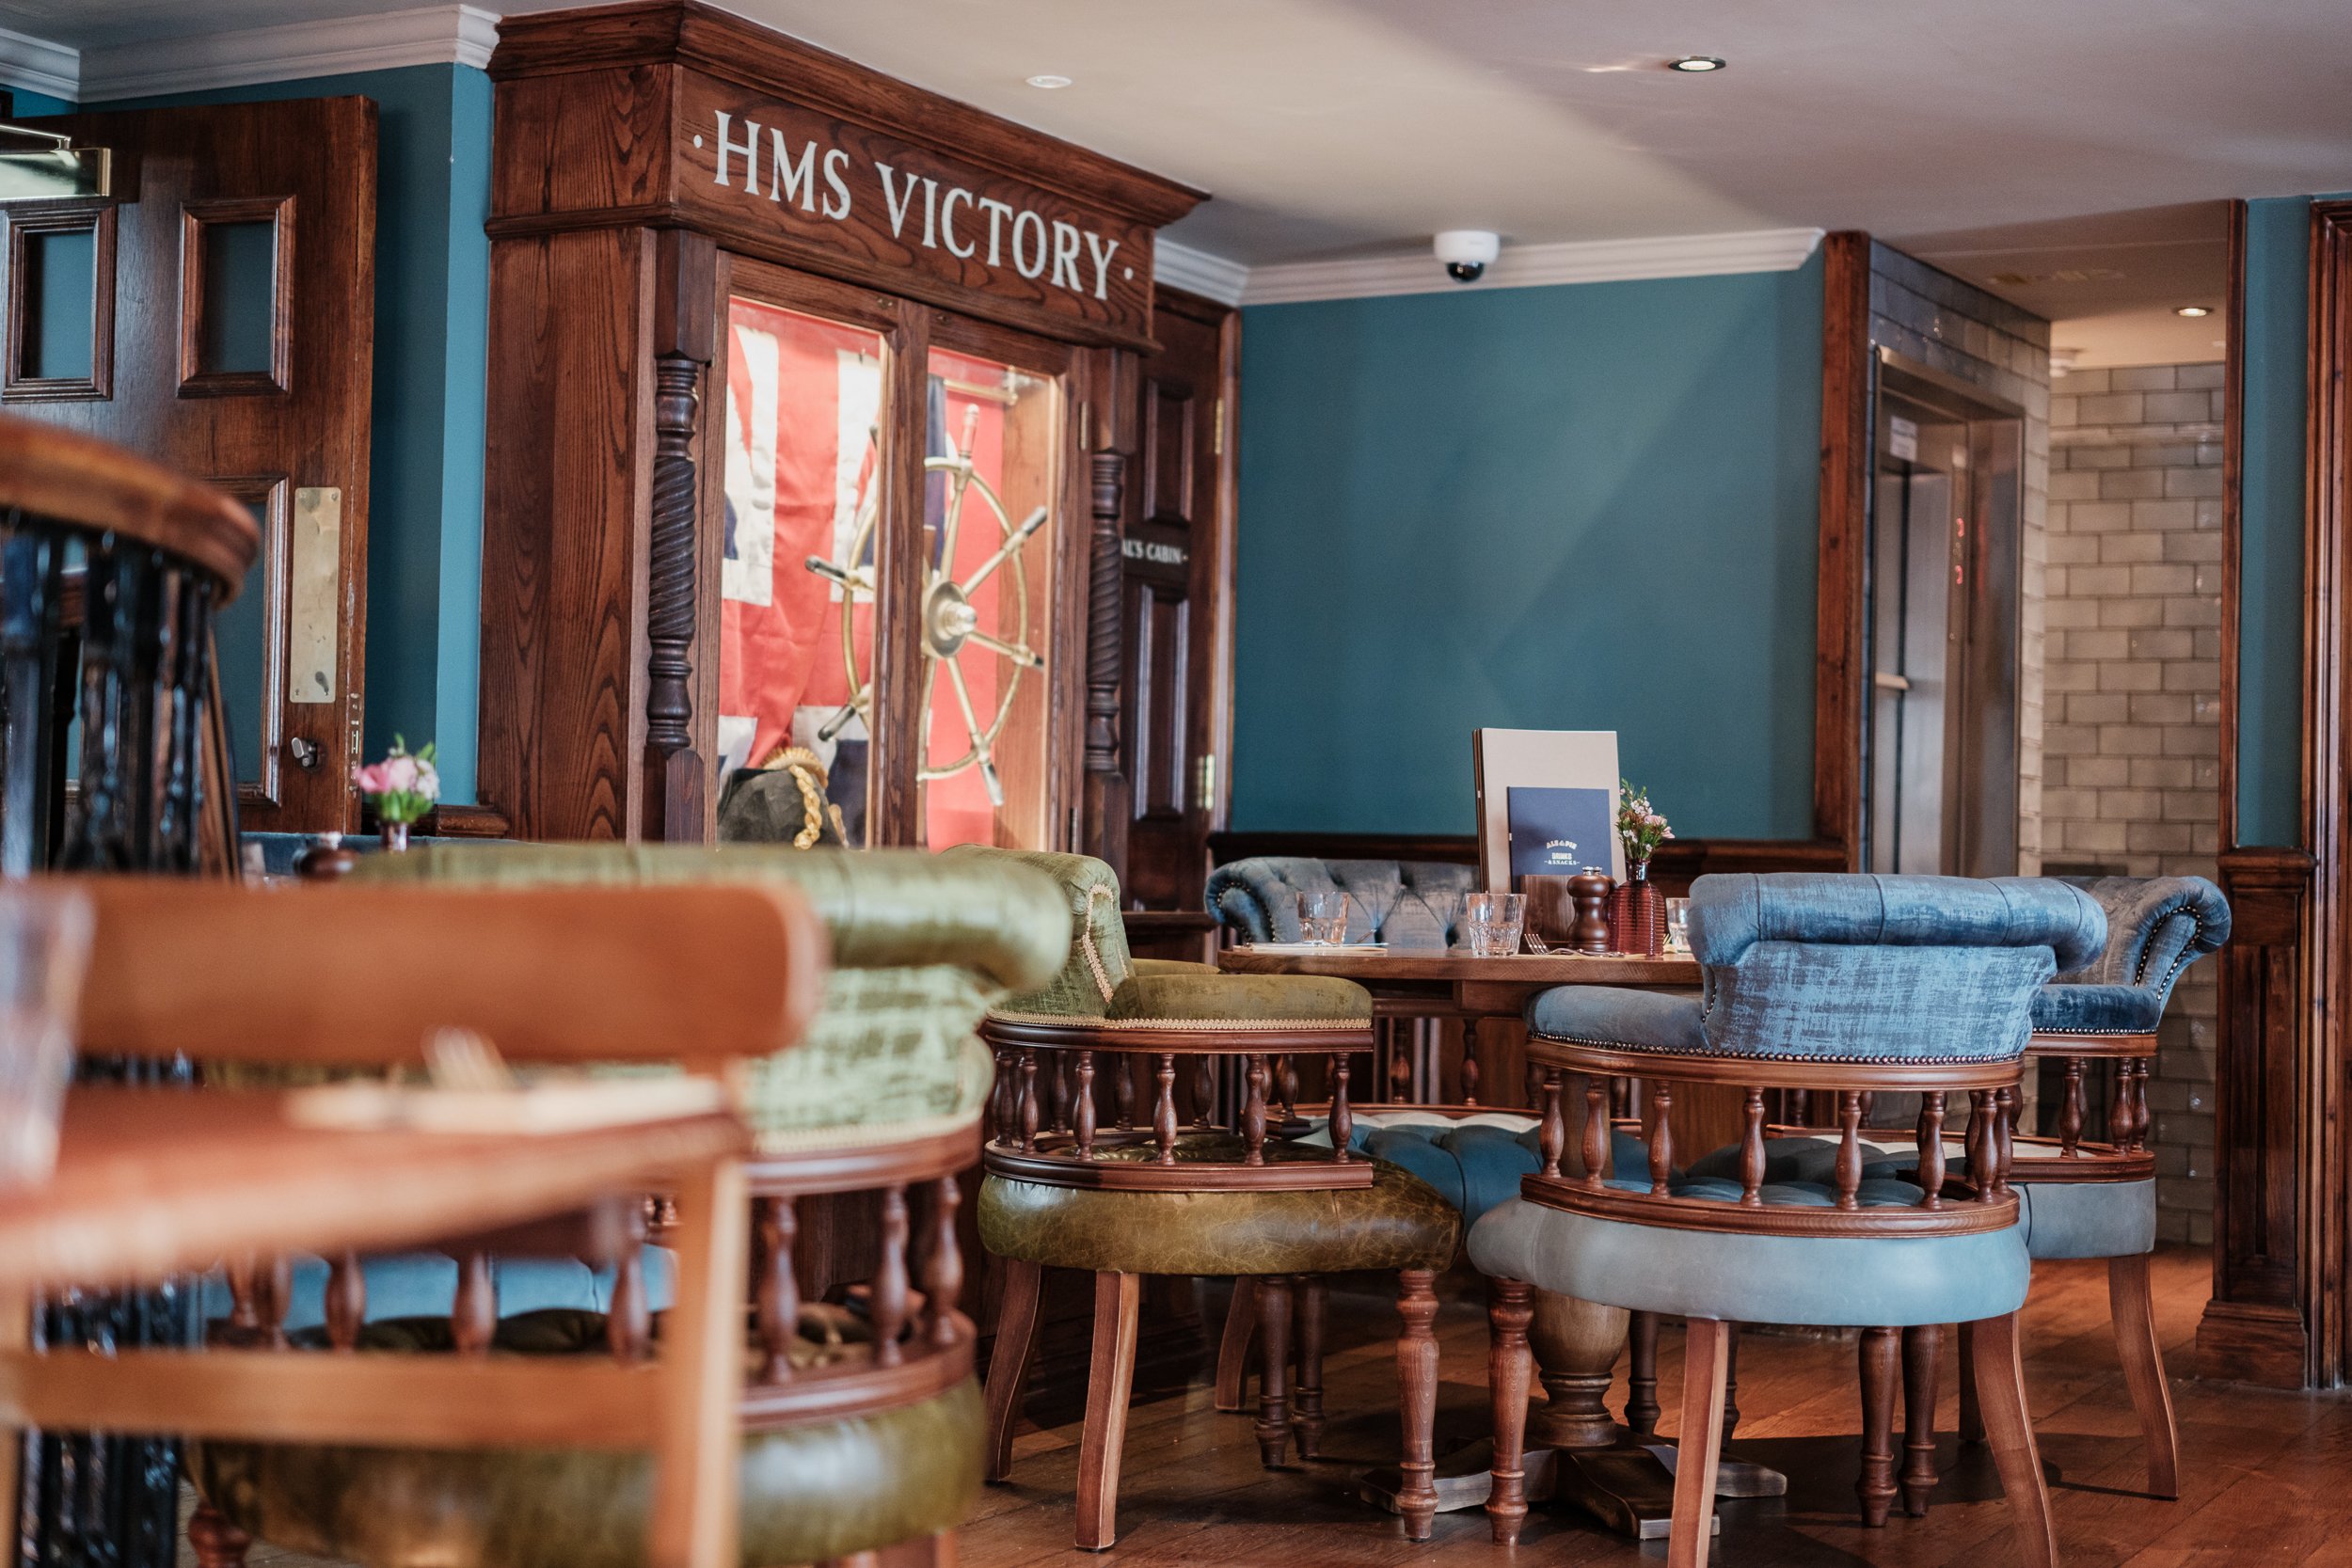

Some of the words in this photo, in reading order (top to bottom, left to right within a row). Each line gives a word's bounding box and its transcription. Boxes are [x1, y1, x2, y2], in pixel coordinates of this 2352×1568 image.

[713, 109, 850, 221] HMS
[874, 161, 1120, 300] VICTORY
[1147, 542, 1182, 564] CABIN
